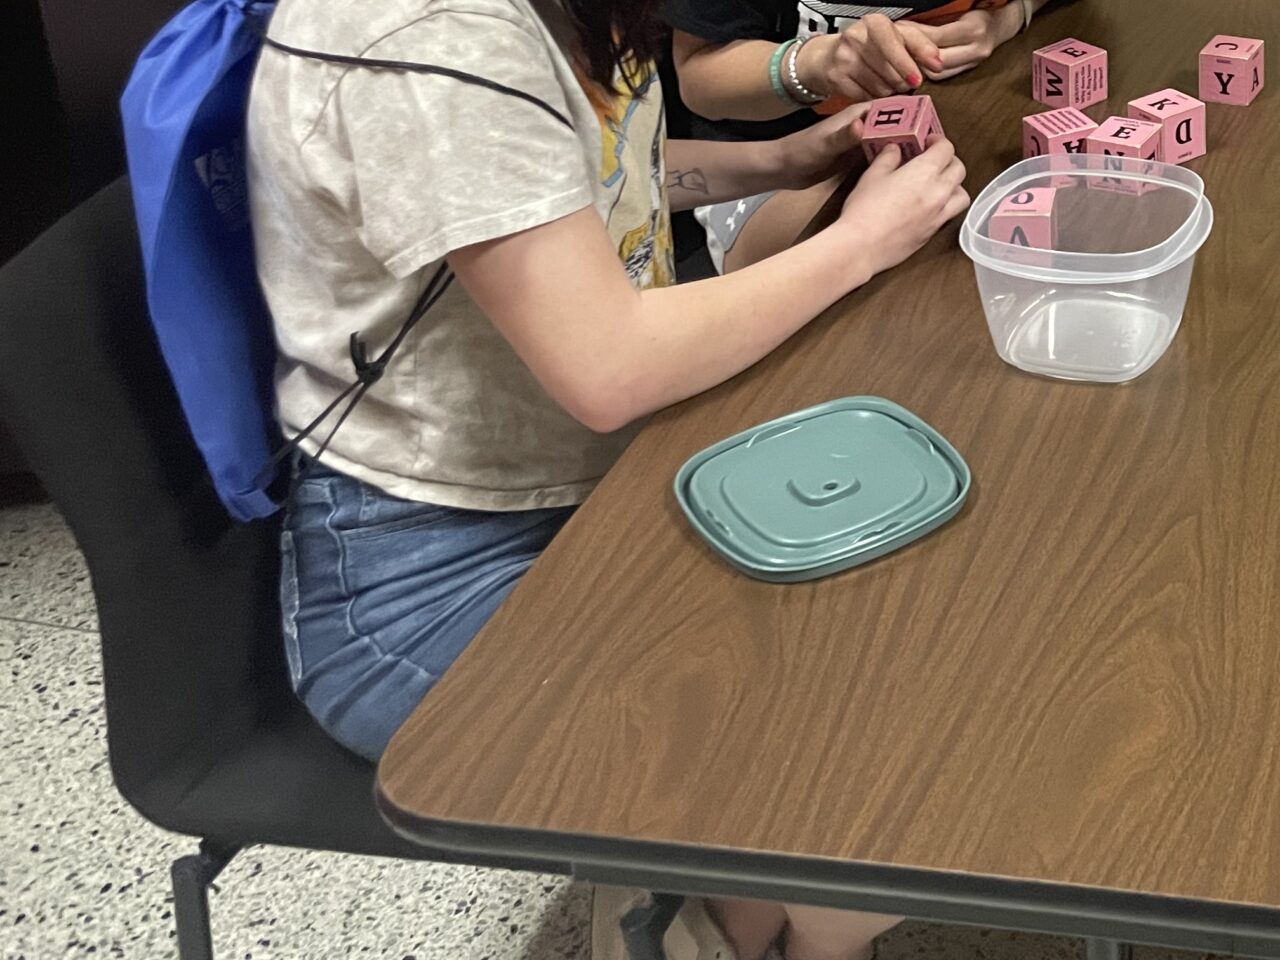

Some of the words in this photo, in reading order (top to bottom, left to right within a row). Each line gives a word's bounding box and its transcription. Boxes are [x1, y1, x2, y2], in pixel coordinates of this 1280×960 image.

[1060, 47, 1088, 58] E
[1213, 71, 1236, 96] Y
[1251, 66, 1260, 93] A
[1148, 98, 1180, 111] K
[874, 108, 905, 127] H
[1110, 126, 1137, 139] E
[1175, 117, 1193, 145] D
[1102, 148, 1125, 185] N
